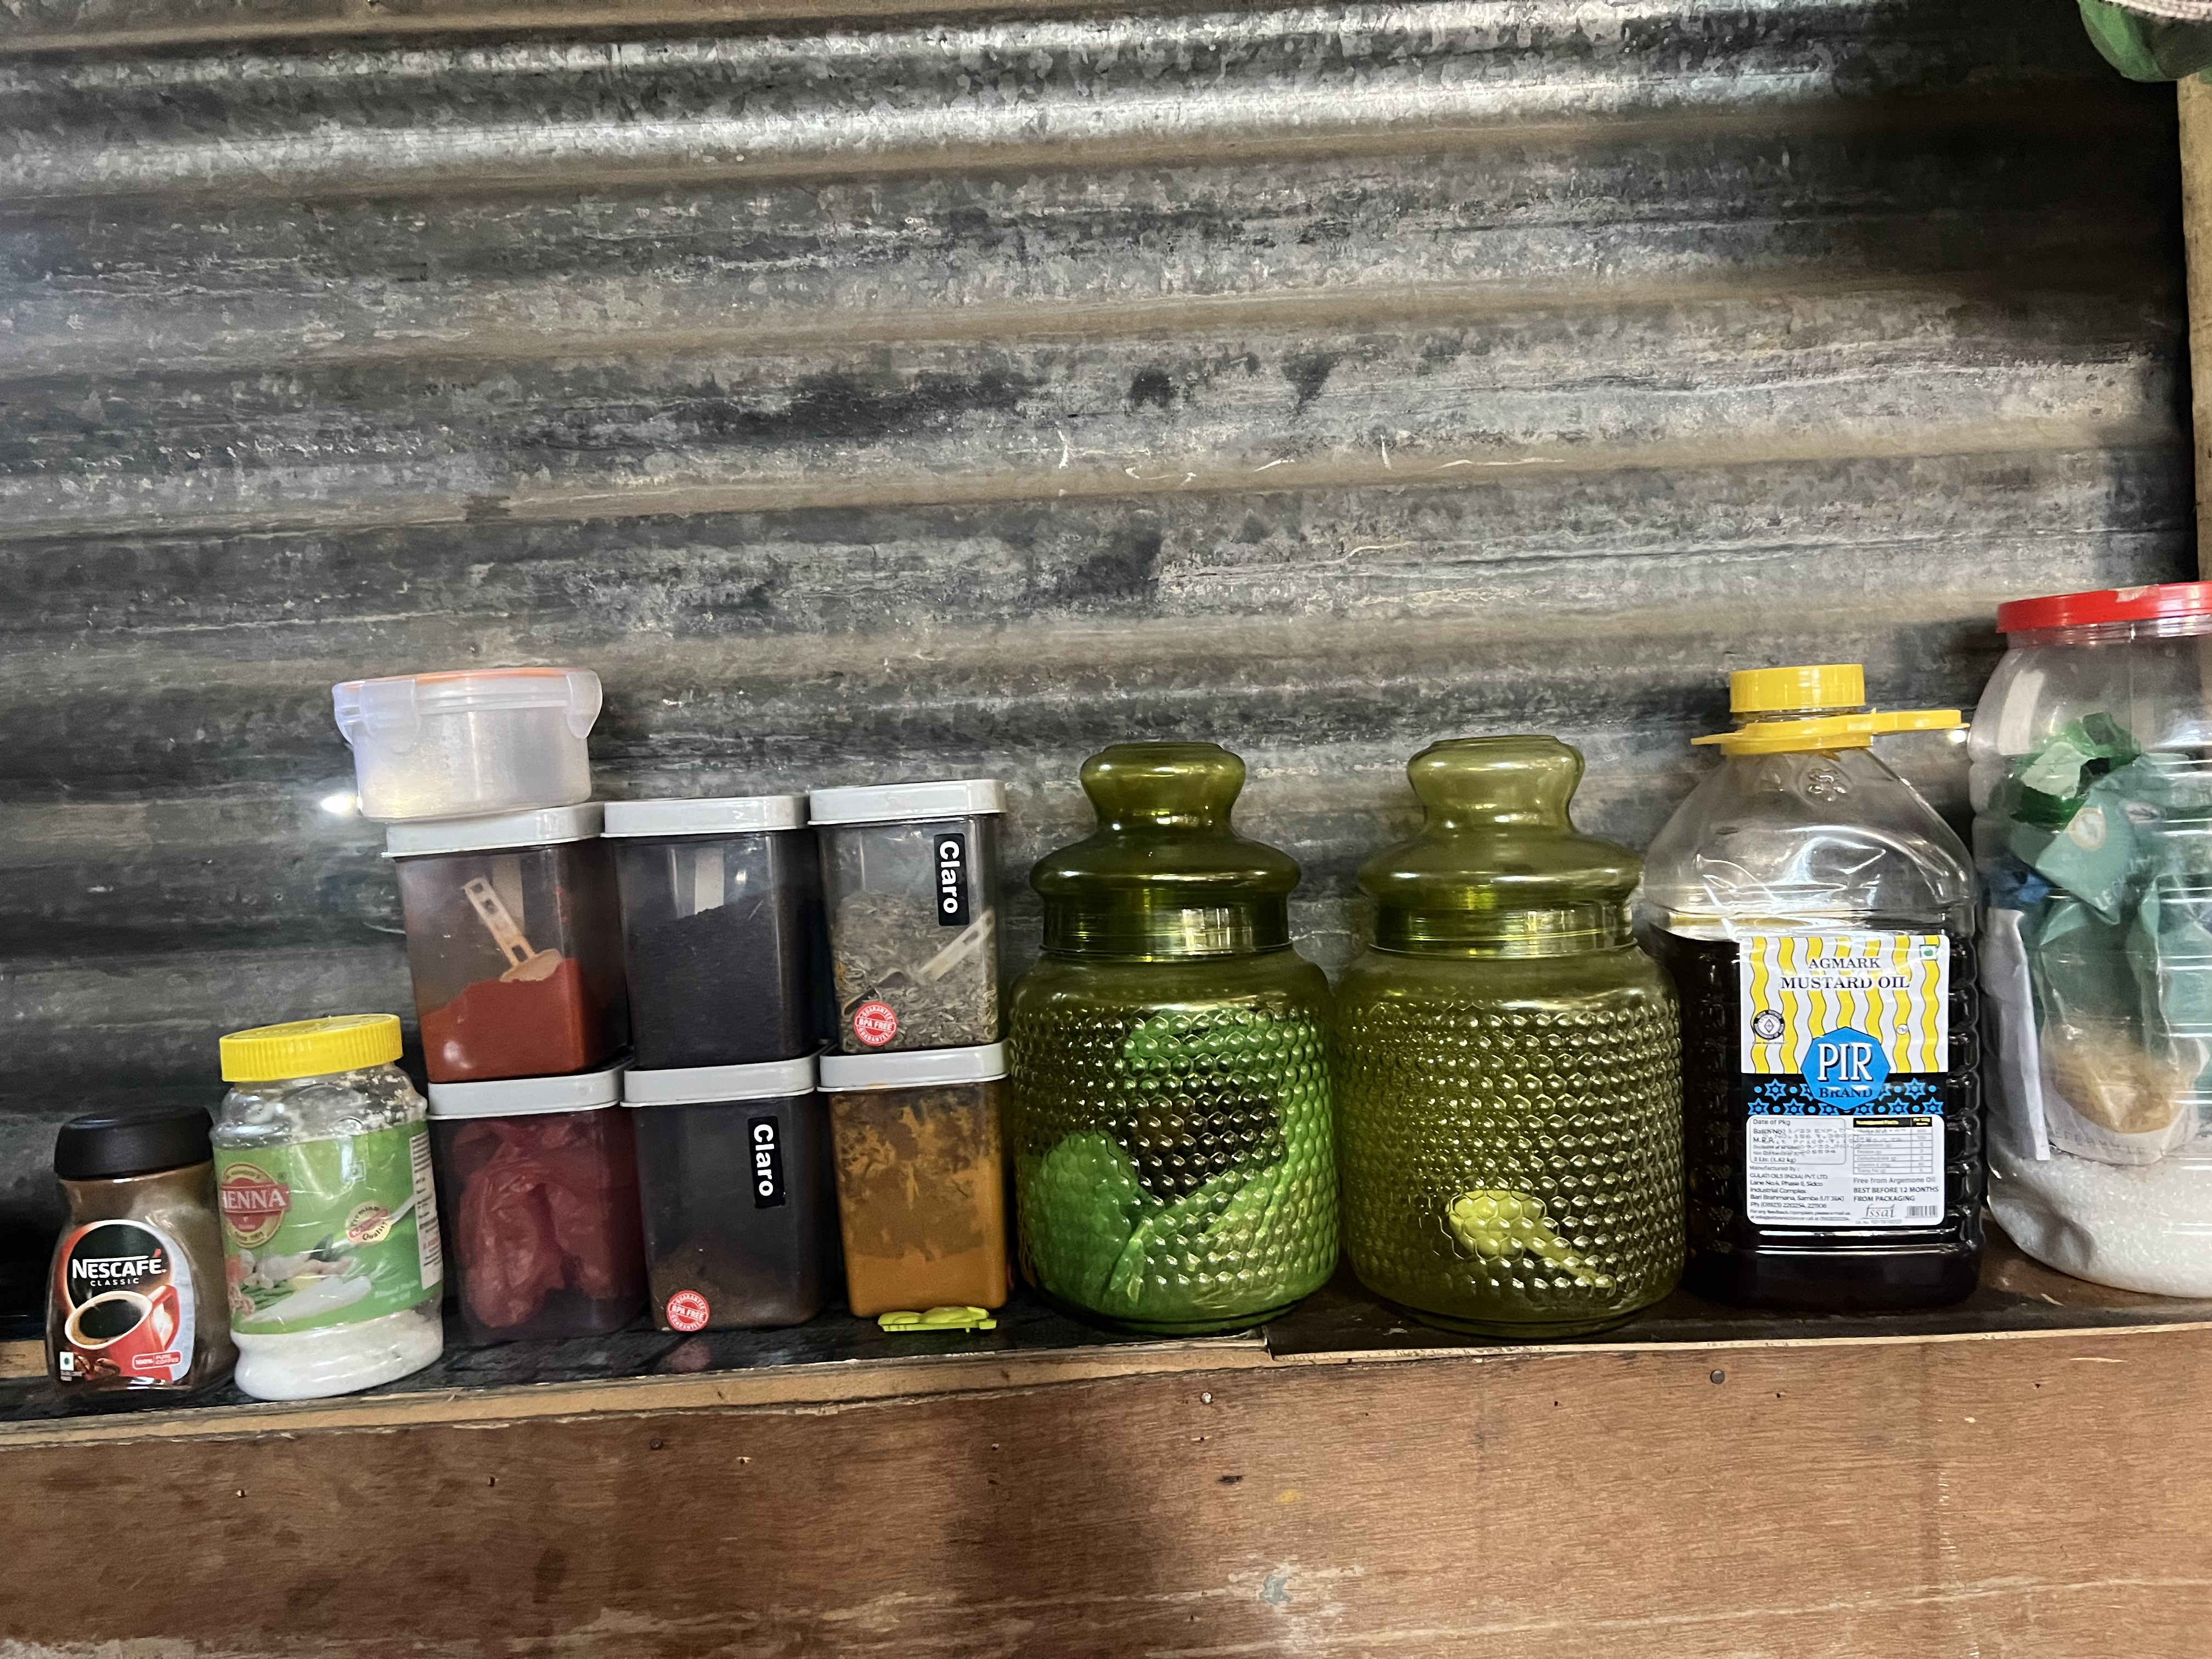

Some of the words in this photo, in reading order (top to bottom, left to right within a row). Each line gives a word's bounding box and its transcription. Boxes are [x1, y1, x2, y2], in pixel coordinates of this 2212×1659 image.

[939, 841, 960, 913] Claro
[1808, 958, 1881, 968] AGMARK
[1781, 977, 1872, 989] MUSTARD
[1878, 977, 1910, 988] OIL
[859, 1018, 873, 1027] BPA
[874, 1021, 893, 1030] FREE
[1817, 1043, 1873, 1081] PIR
[1819, 1087, 1873, 1098] BRAND
[754, 1124, 775, 1197] Claro
[91, 1278, 139, 1286] CLASSIC
[672, 1305, 685, 1314] BPA
[686, 1310, 704, 1321] FREE
